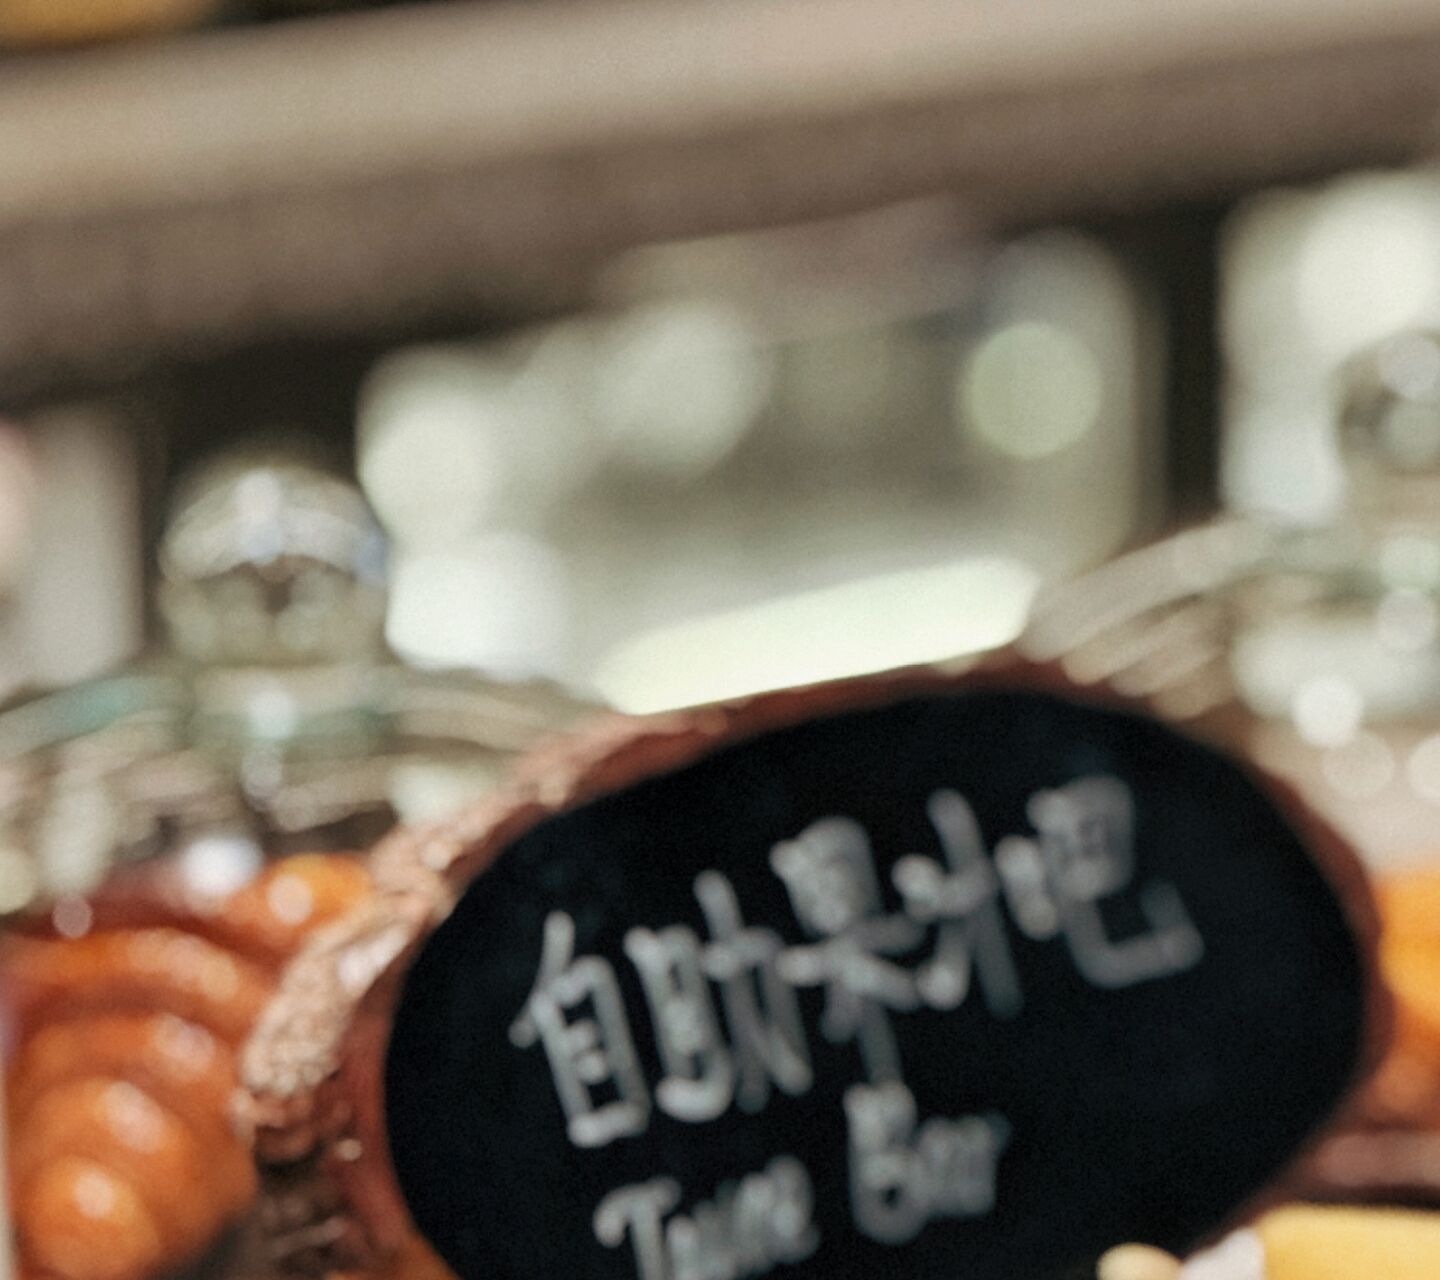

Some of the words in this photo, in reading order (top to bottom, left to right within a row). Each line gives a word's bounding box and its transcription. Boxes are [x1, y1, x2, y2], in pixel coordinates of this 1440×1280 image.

[510, 775, 1201, 1148] 自助果汁吧
